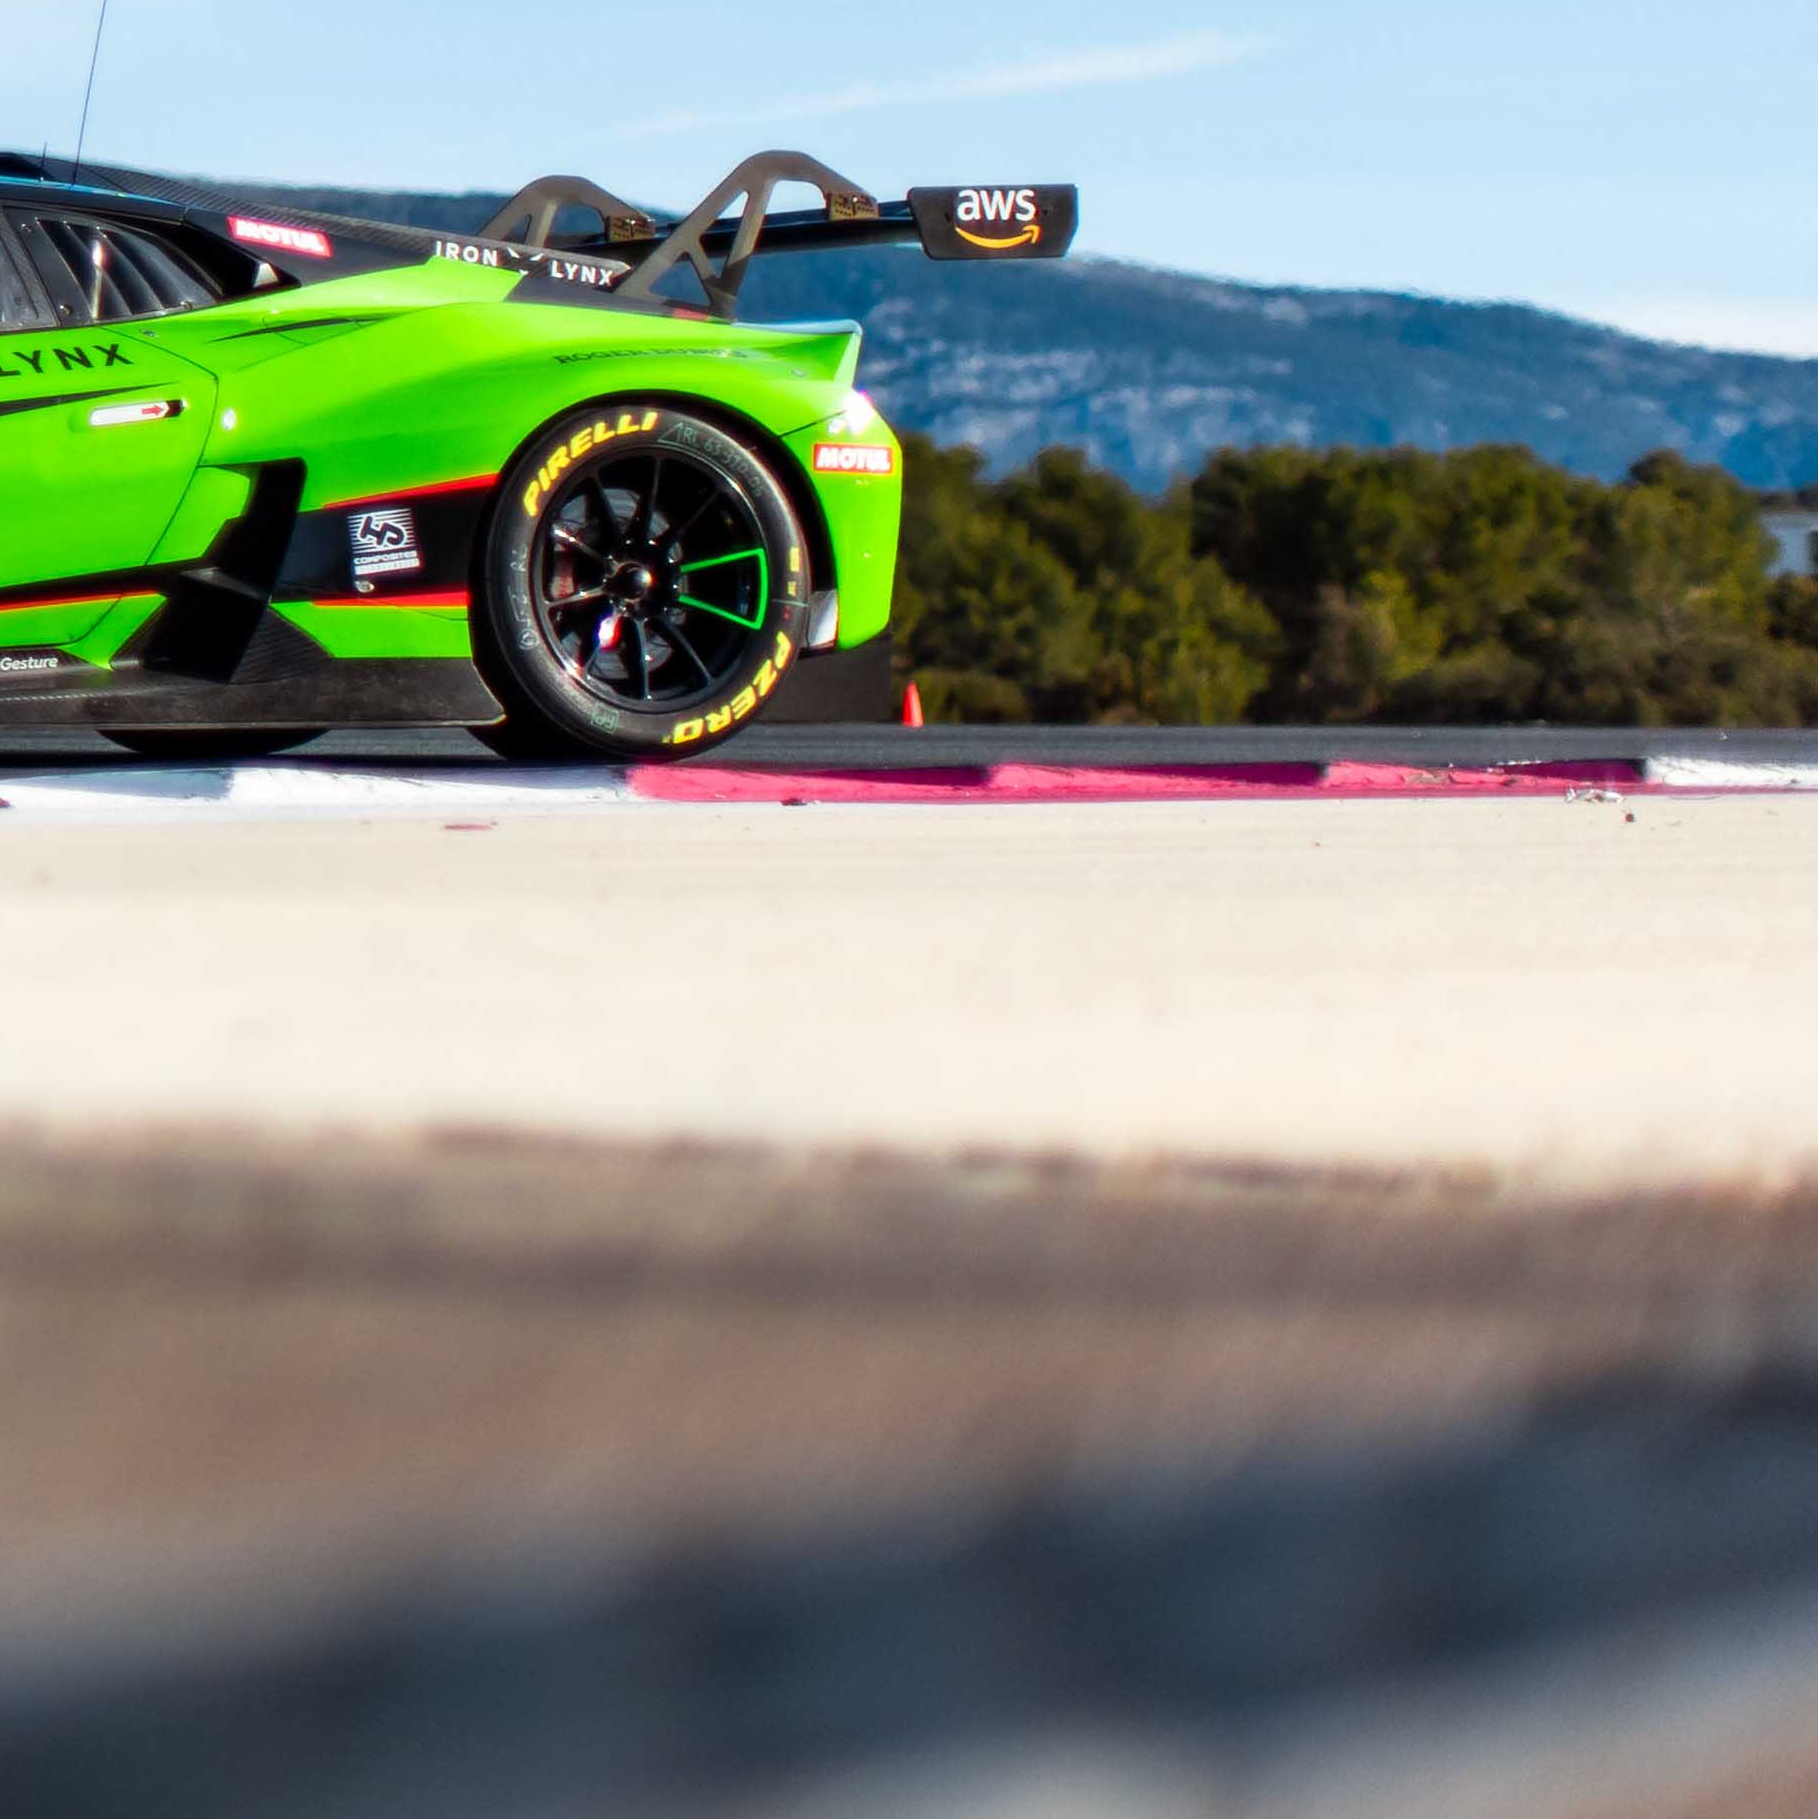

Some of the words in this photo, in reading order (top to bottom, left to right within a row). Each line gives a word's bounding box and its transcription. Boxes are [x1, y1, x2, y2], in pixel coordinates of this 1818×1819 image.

[957, 188, 1037, 222] aws
[235, 219, 325, 253] MOTUL
[434, 240, 498, 266] IRON
[550, 259, 613, 286] LYNX
[522, 411, 659, 517] PIRELLI
[816, 447, 891, 471] MOTUL
